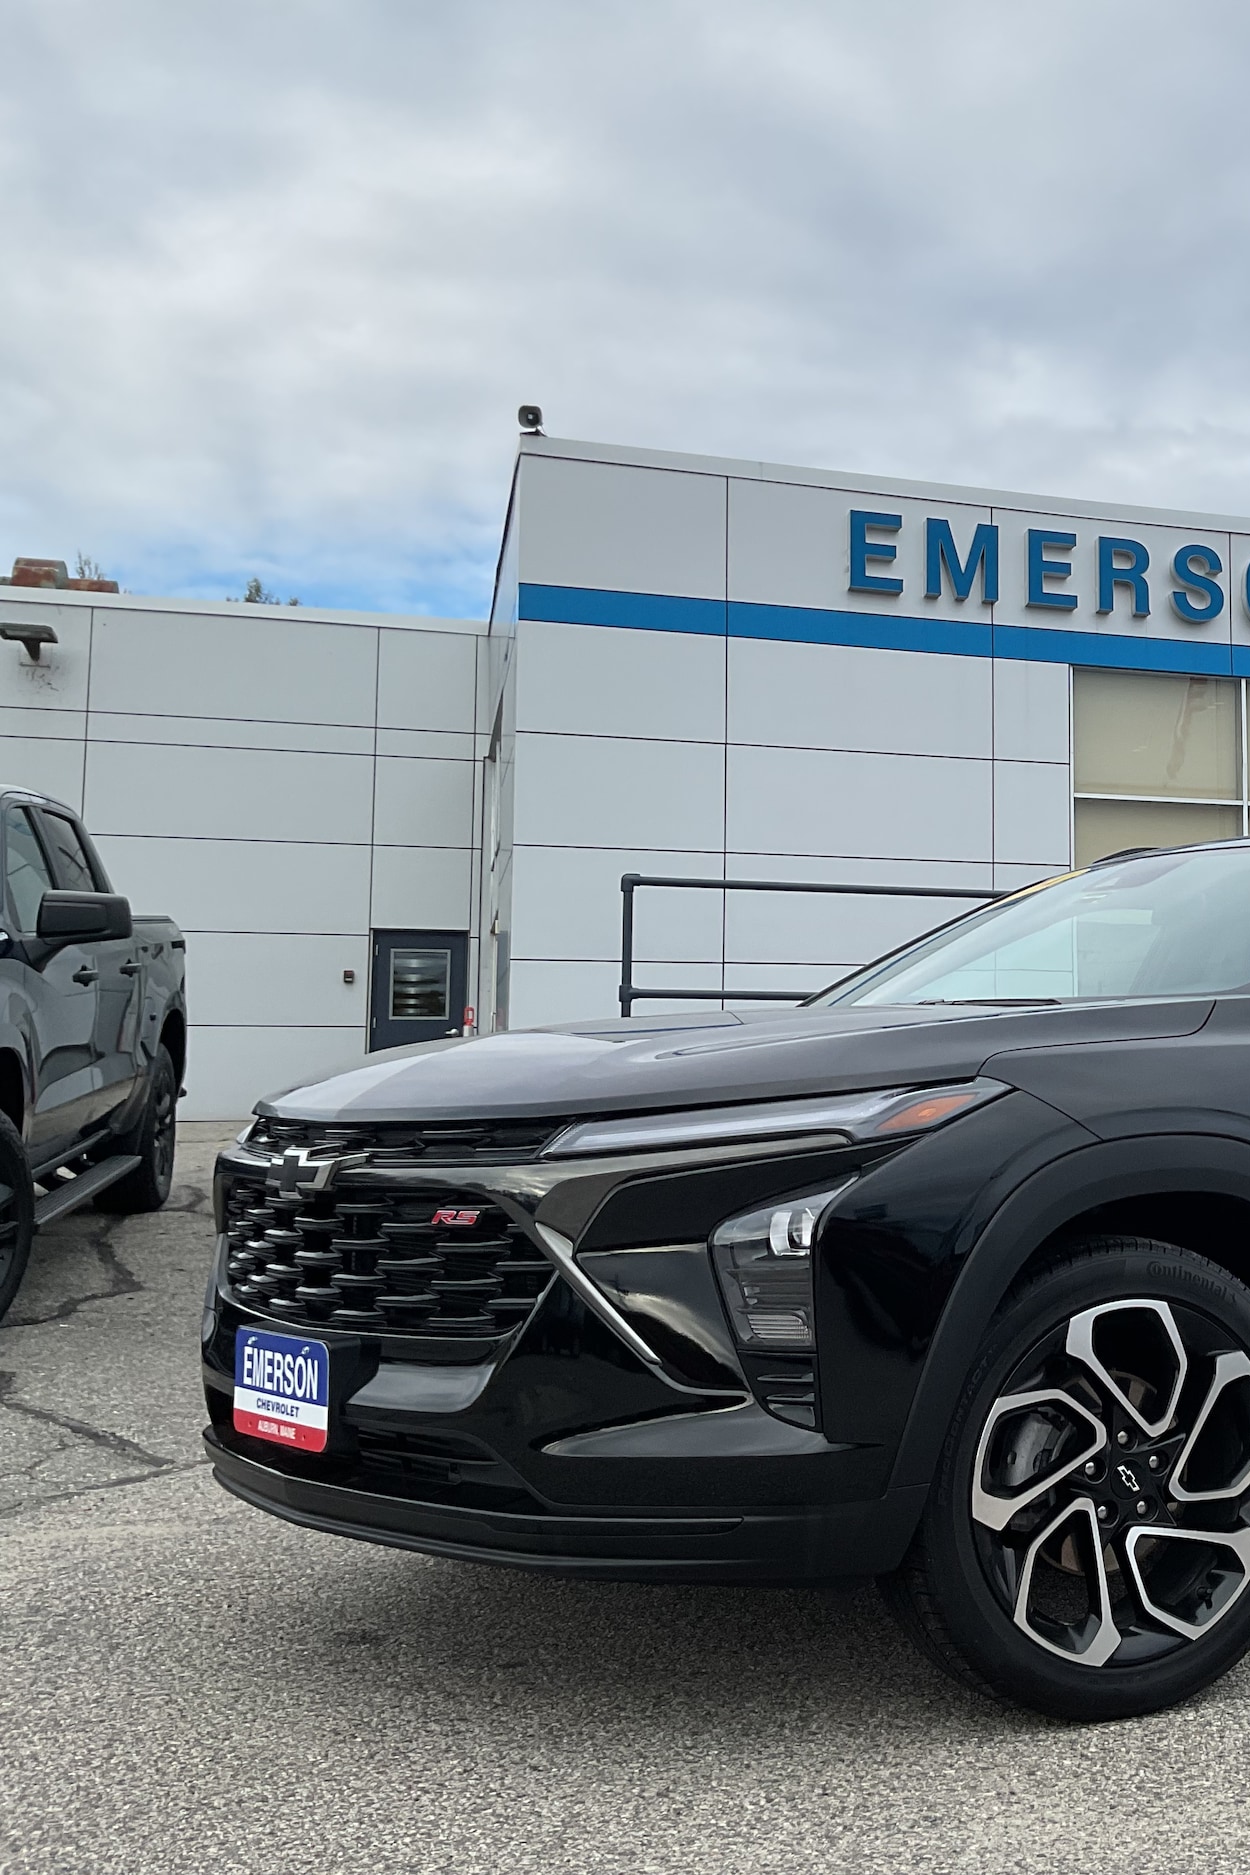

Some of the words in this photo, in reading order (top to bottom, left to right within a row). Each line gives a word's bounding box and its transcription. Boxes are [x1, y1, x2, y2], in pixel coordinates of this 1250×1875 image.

[431, 1210, 481, 1225] RS
[1146, 1261, 1227, 1300] Continental
[243, 1346, 318, 1400] EMERSON
[256, 1398, 300, 1418] CHEVROLET
